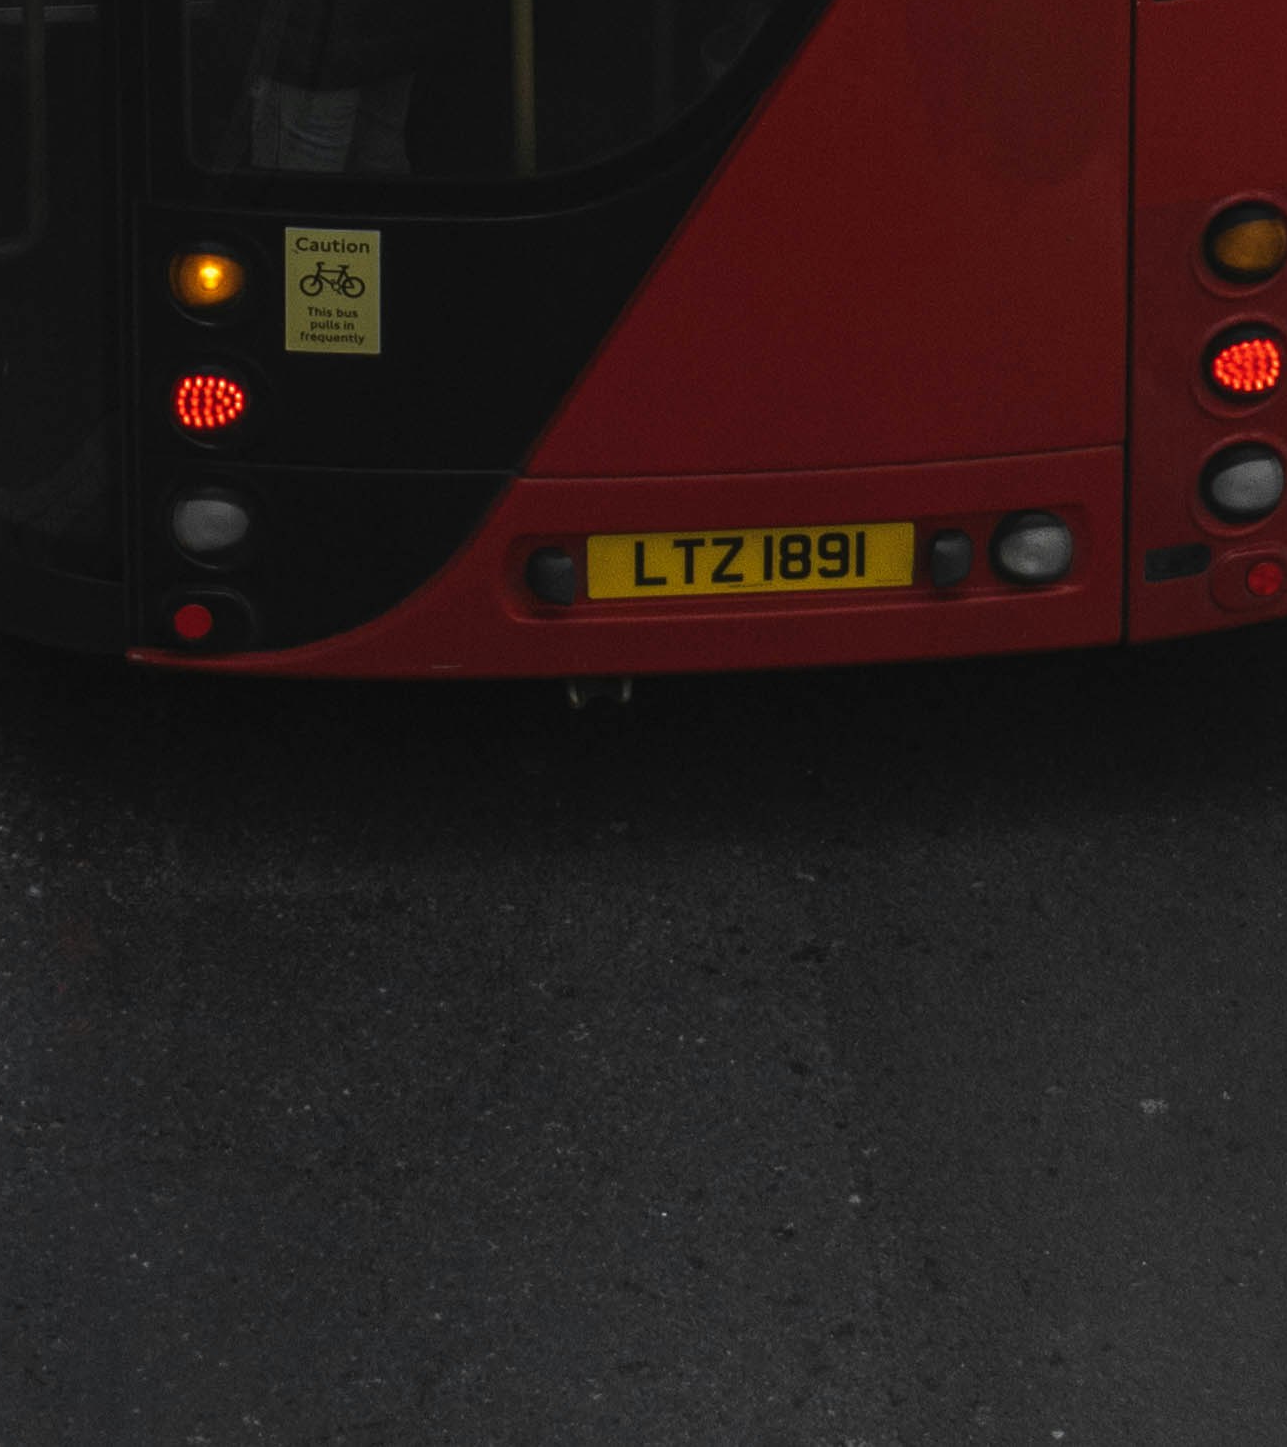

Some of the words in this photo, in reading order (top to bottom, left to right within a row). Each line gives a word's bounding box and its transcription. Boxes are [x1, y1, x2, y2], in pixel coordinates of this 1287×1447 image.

[295, 236, 370, 254] Caution
[308, 306, 333, 318] This
[336, 306, 359, 318] bus
[310, 320, 340, 332] pulls
[343, 320, 355, 330] in
[299, 331, 366, 347] frequently
[634, 535, 745, 587] LTZ
[762, 530, 866, 582] 1891
